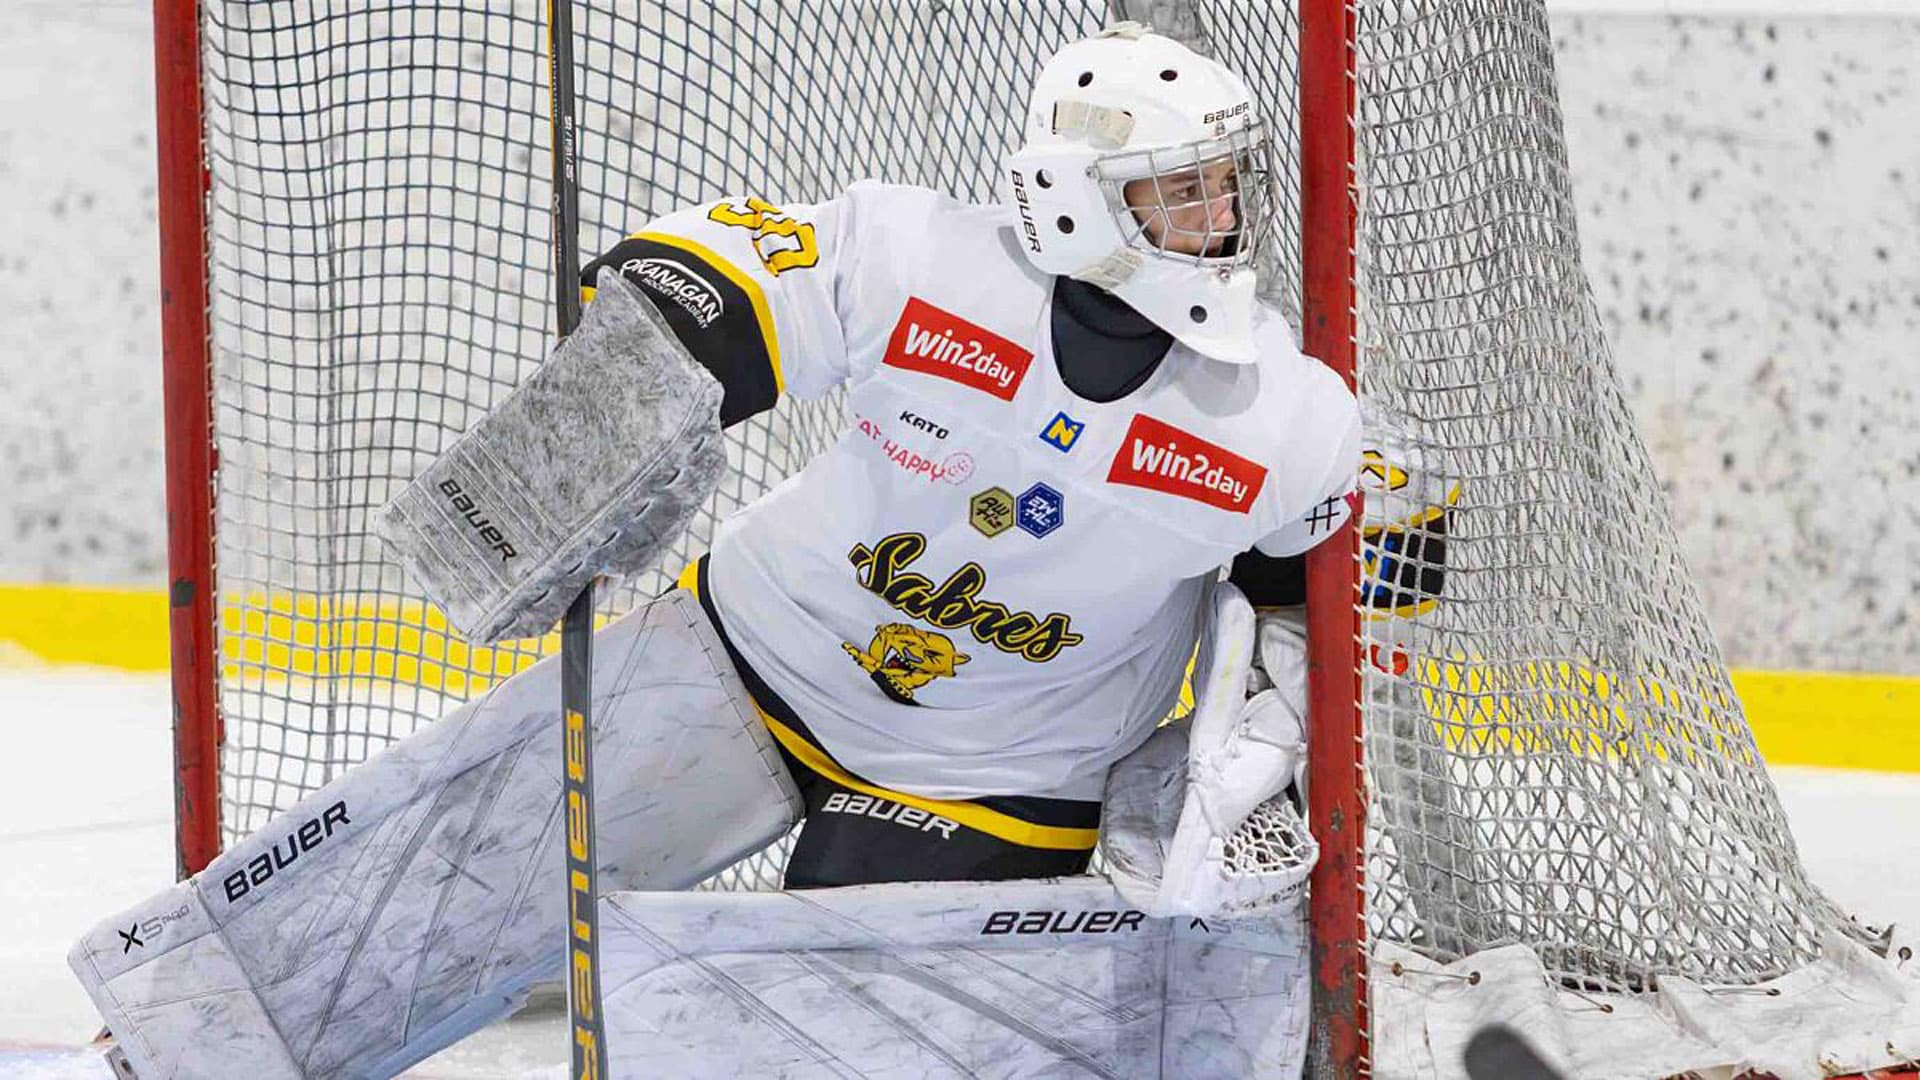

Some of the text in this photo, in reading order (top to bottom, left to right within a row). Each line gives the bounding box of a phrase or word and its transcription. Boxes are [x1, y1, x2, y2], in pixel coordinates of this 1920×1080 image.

[1203, 102, 1250, 124] BAUER
[1011, 169, 1042, 253] BAUER
[622, 259, 720, 323] OKANAGAN
[674, 294, 709, 329] ACADEMY
[900, 410, 949, 440] KATO
[882, 440, 946, 482] HAPPY
[439, 478, 517, 561] BAUER
[848, 532, 1084, 663] Sabres
[821, 792, 960, 840] BAUER
[223, 800, 352, 903] BAUER
[981, 910, 1147, 935] BAUER
